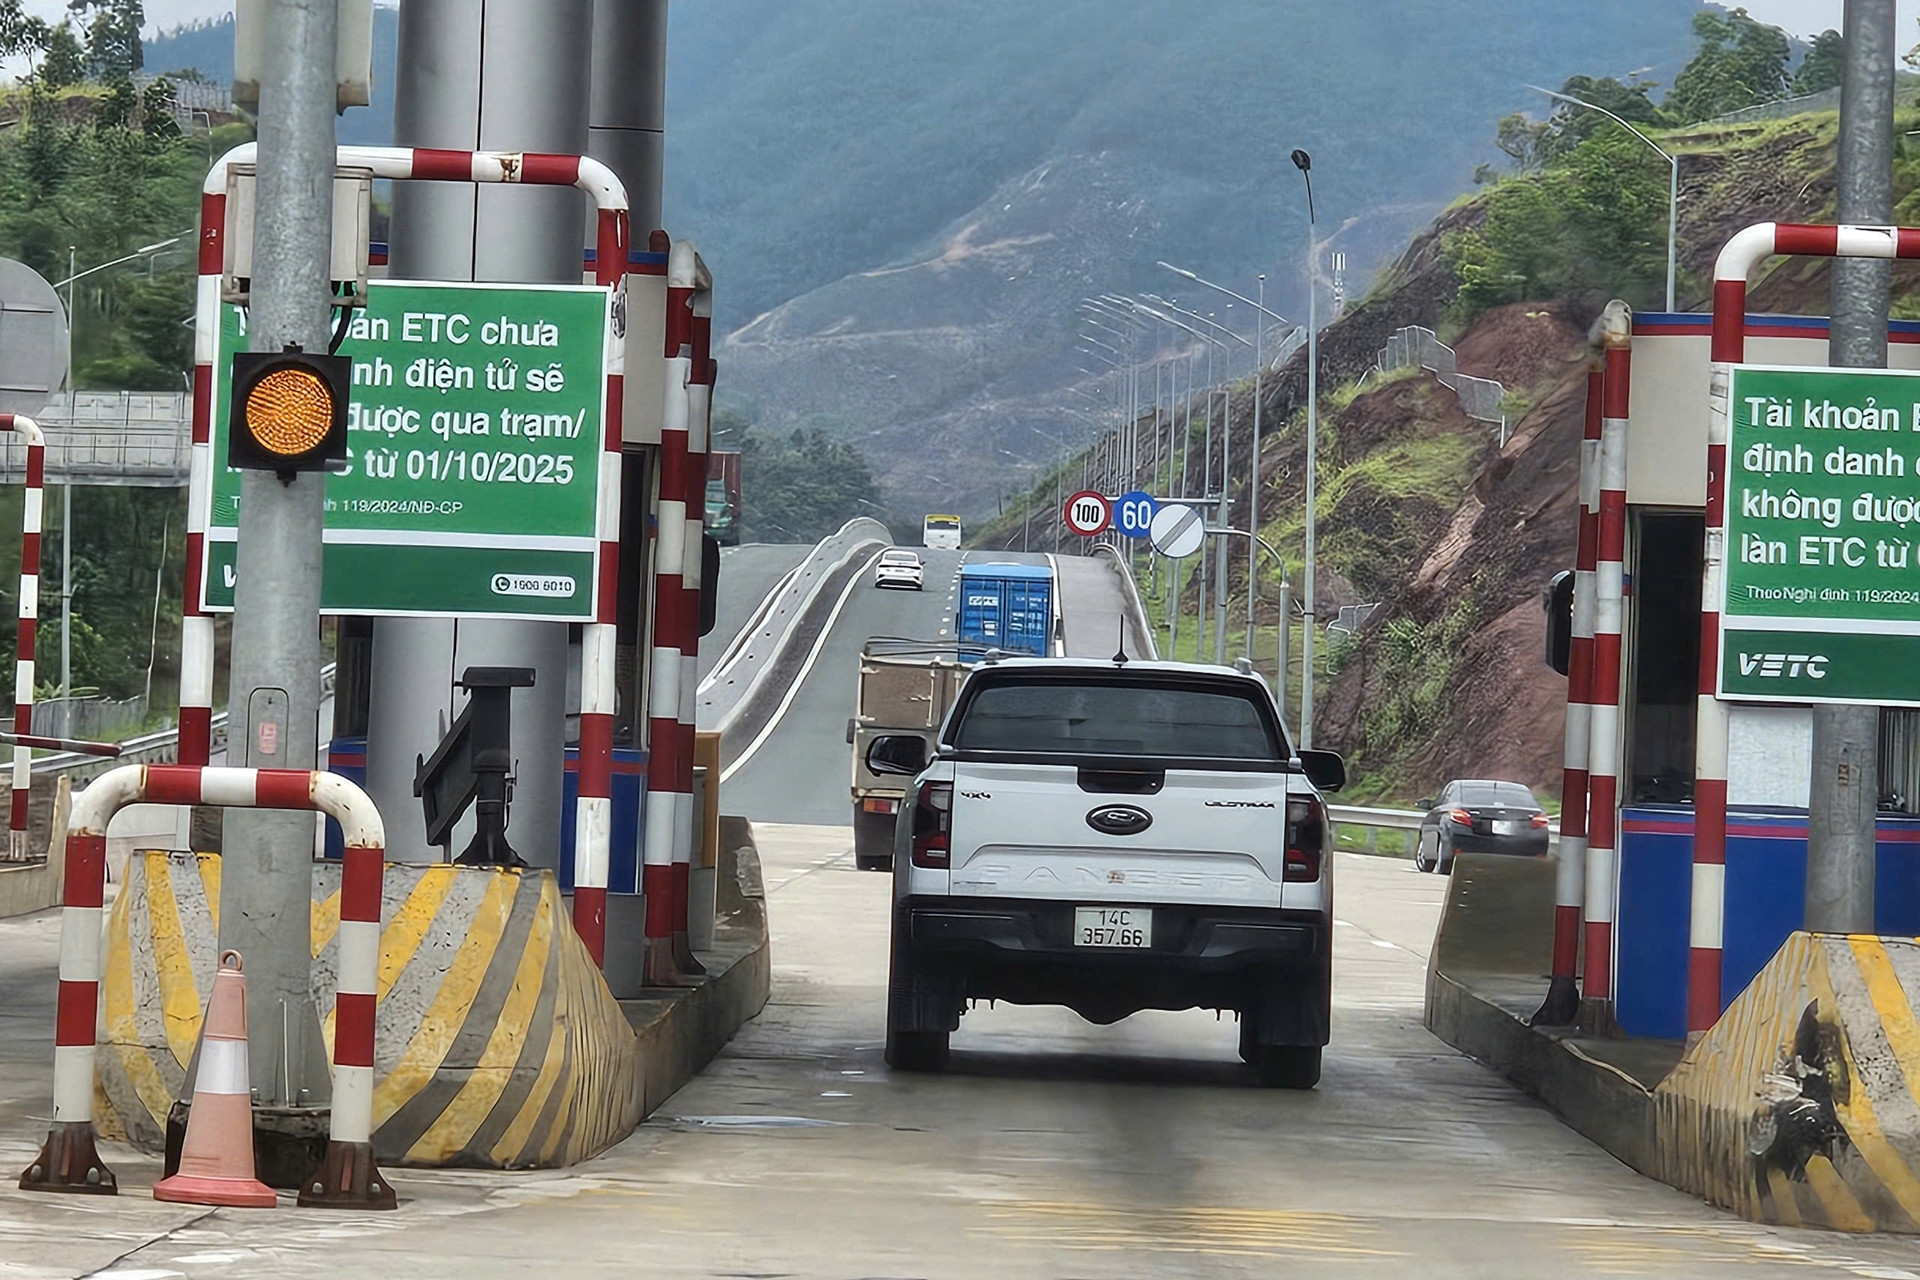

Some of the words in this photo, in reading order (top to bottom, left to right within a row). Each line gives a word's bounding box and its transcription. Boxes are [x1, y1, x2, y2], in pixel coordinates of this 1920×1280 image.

[402, 312, 471, 344] ETC
[480, 316, 559, 347] chưa
[405, 358, 474, 394] điện
[485, 357, 518, 391] tử
[525, 362, 564, 393] sẽ
[431, 410, 490, 442] qua
[500, 407, 586, 442] trạm/
[1744, 397, 1793, 428] Tài
[1804, 397, 1900, 432] khoản
[364, 447, 399, 478] từ
[406, 450, 574, 485] 01/10/2025
[1743, 442, 1814, 478] định
[1824, 446, 1905, 477] danh
[1075, 503, 1100, 523] 100
[1122, 500, 1152, 530] 60
[1742, 488, 1842, 529] không
[1741, 533, 1787, 564] làn
[1799, 536, 1867, 567] ETC
[1876, 537, 1911, 569] từ
[1739, 653, 1829, 679] VETC
[1099, 909, 1131, 927] 14C
[1083, 927, 1143, 947] 357.66
